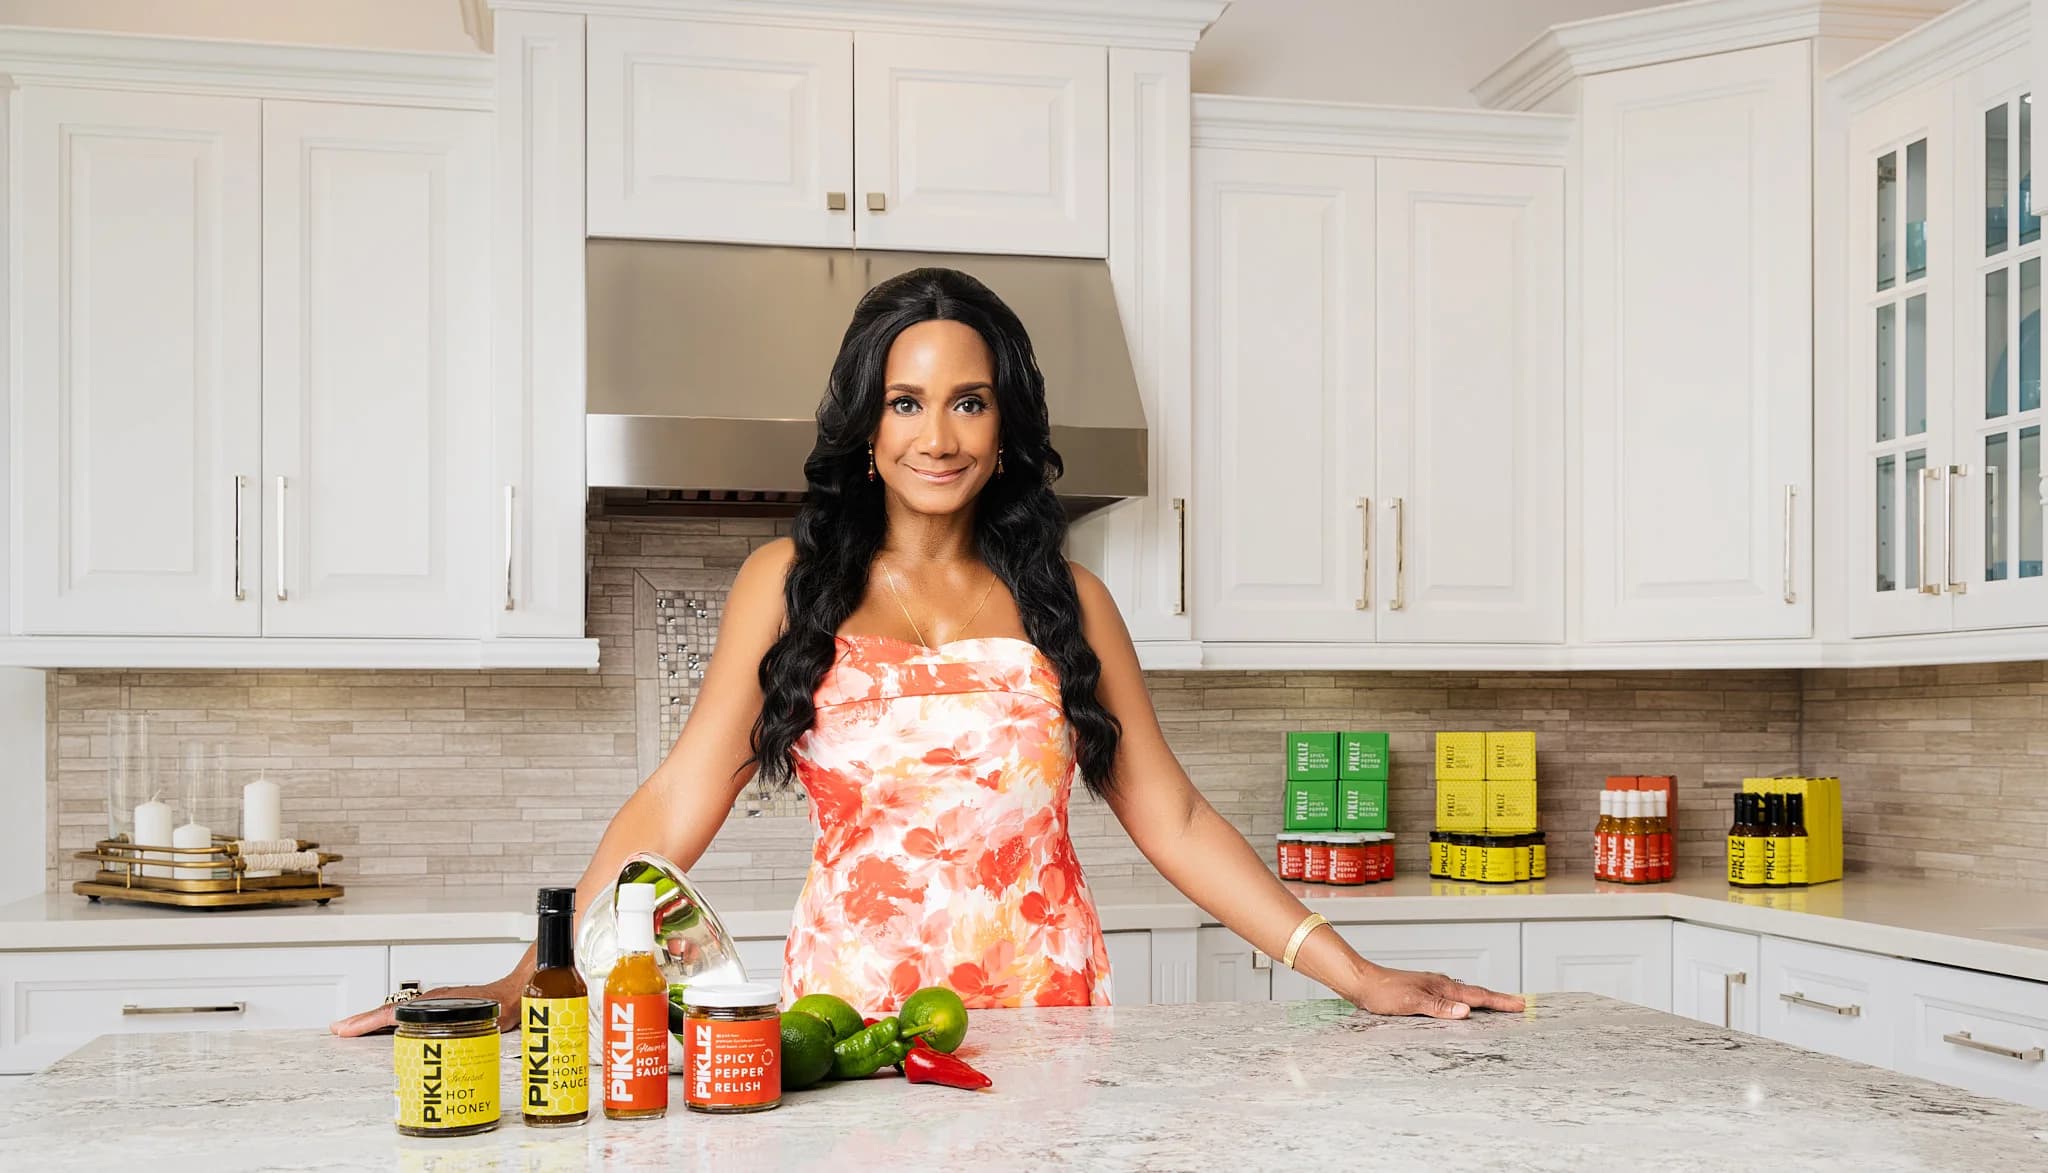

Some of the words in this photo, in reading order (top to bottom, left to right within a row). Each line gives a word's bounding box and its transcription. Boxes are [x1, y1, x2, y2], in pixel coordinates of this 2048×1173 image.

[1297, 742, 1308, 771] PIKLIZ
[1348, 742, 1360, 771] PIKLIZ
[1446, 745, 1455, 768] PIKLIZ
[1496, 745, 1505, 768] PIKLIZ
[1296, 791, 1307, 820] PIKLIZ
[1346, 791, 1358, 820] PIKLIZ
[1447, 794, 1455, 817] PIKLIZ
[1496, 794, 1505, 817] PIKLIZ
[1607, 836, 1616, 875] PIKLIZ
[1624, 838, 1635, 878] PIKLIZ
[1766, 840, 1775, 880] PIKLIZ
[529, 1006, 549, 1107] PIKLIZ
[552, 1055, 577, 1065] HOT
[611, 1003, 634, 1102] PIKLIZ
[636, 1056, 660, 1067] HOT
[696, 1025, 712, 1099] PIKLIZ
[715, 1053, 755, 1065] SPICY
[636, 1065, 667, 1077] SAUCE
[715, 1067, 764, 1079] PEPPER
[424, 1044, 442, 1122] PIKLIZ
[446, 1089, 476, 1100] HOT
[552, 1077, 588, 1090] SAUCE
[715, 1081, 761, 1093] RELISH
[446, 1101, 492, 1115] HONEY
